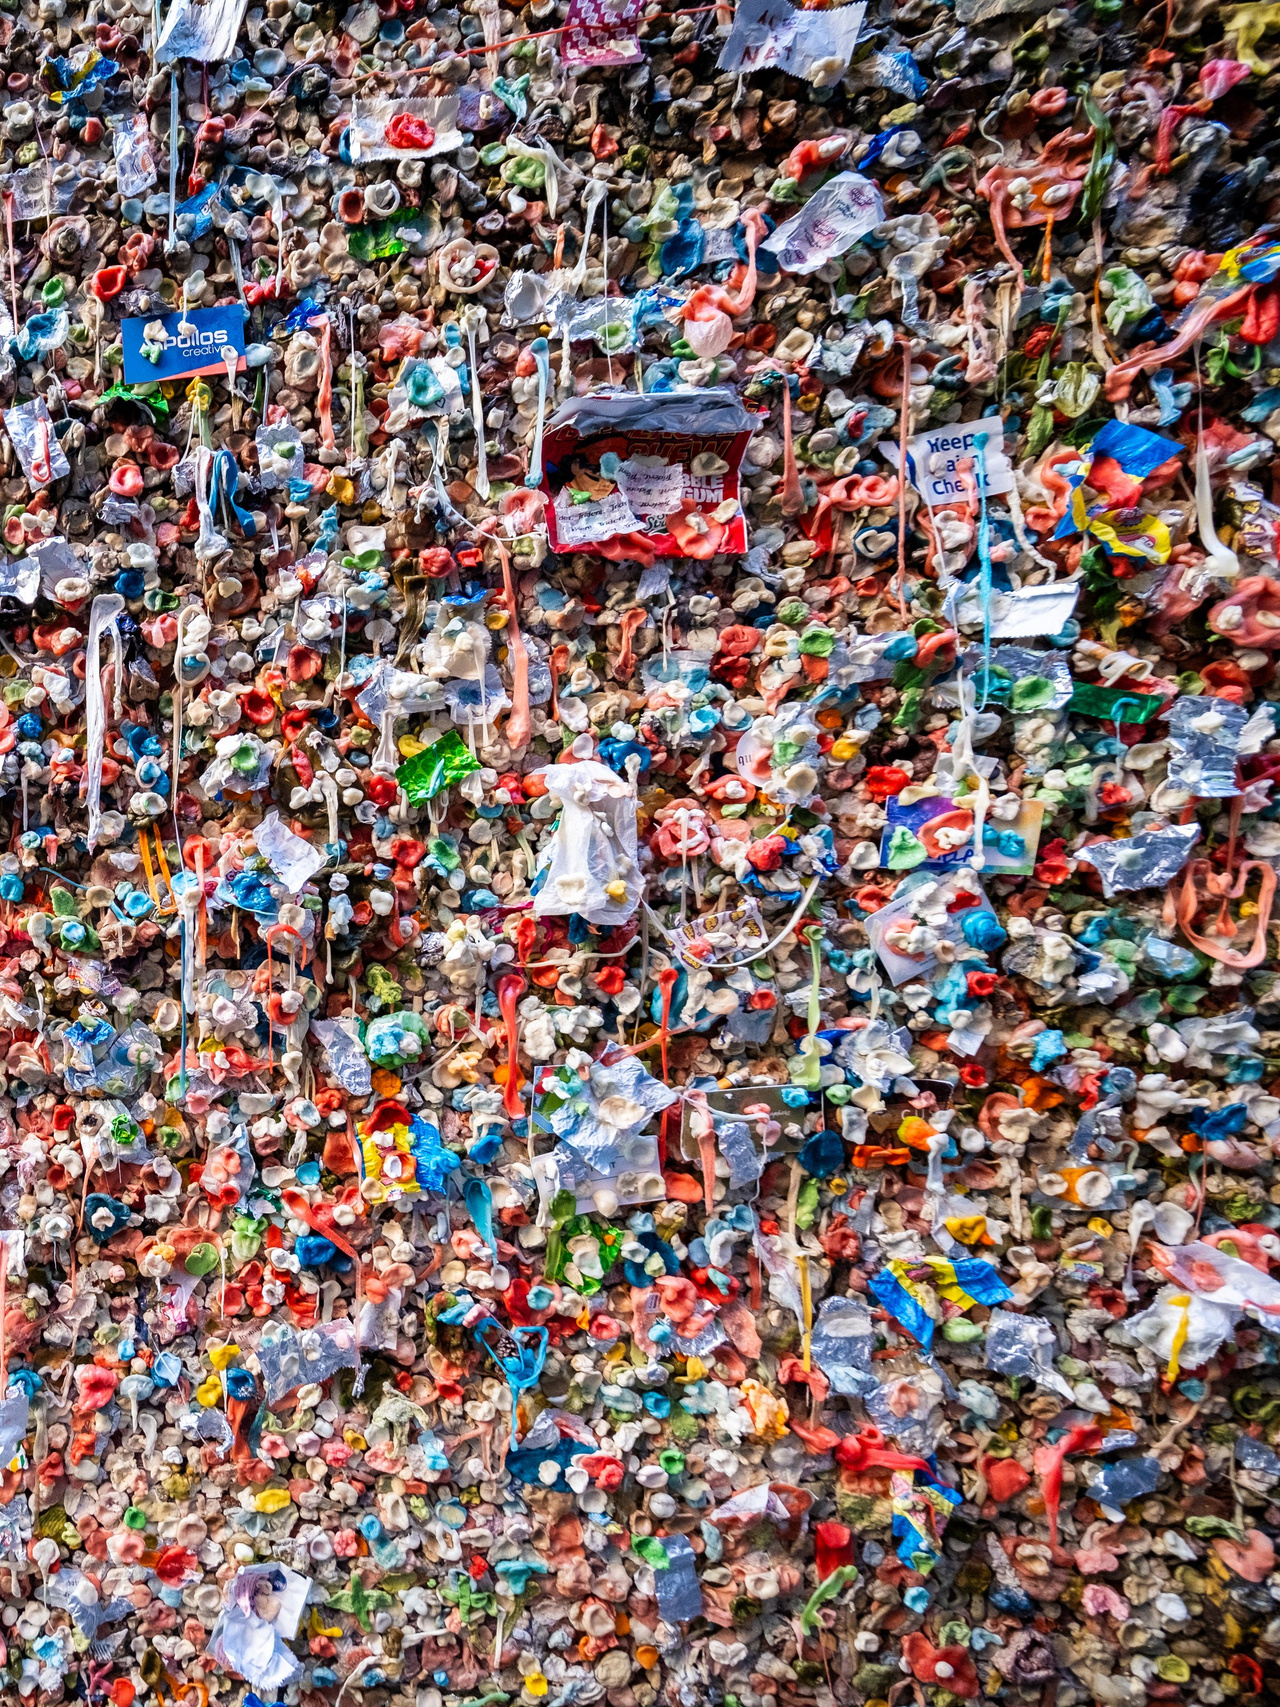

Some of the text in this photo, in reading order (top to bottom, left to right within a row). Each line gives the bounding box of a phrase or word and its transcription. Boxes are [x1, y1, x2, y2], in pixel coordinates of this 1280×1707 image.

[144, 329, 228, 351] pollos
[182, 344, 228, 358] creativ
[932, 473, 991, 495] Chek
[681, 487, 724, 503] GUM
